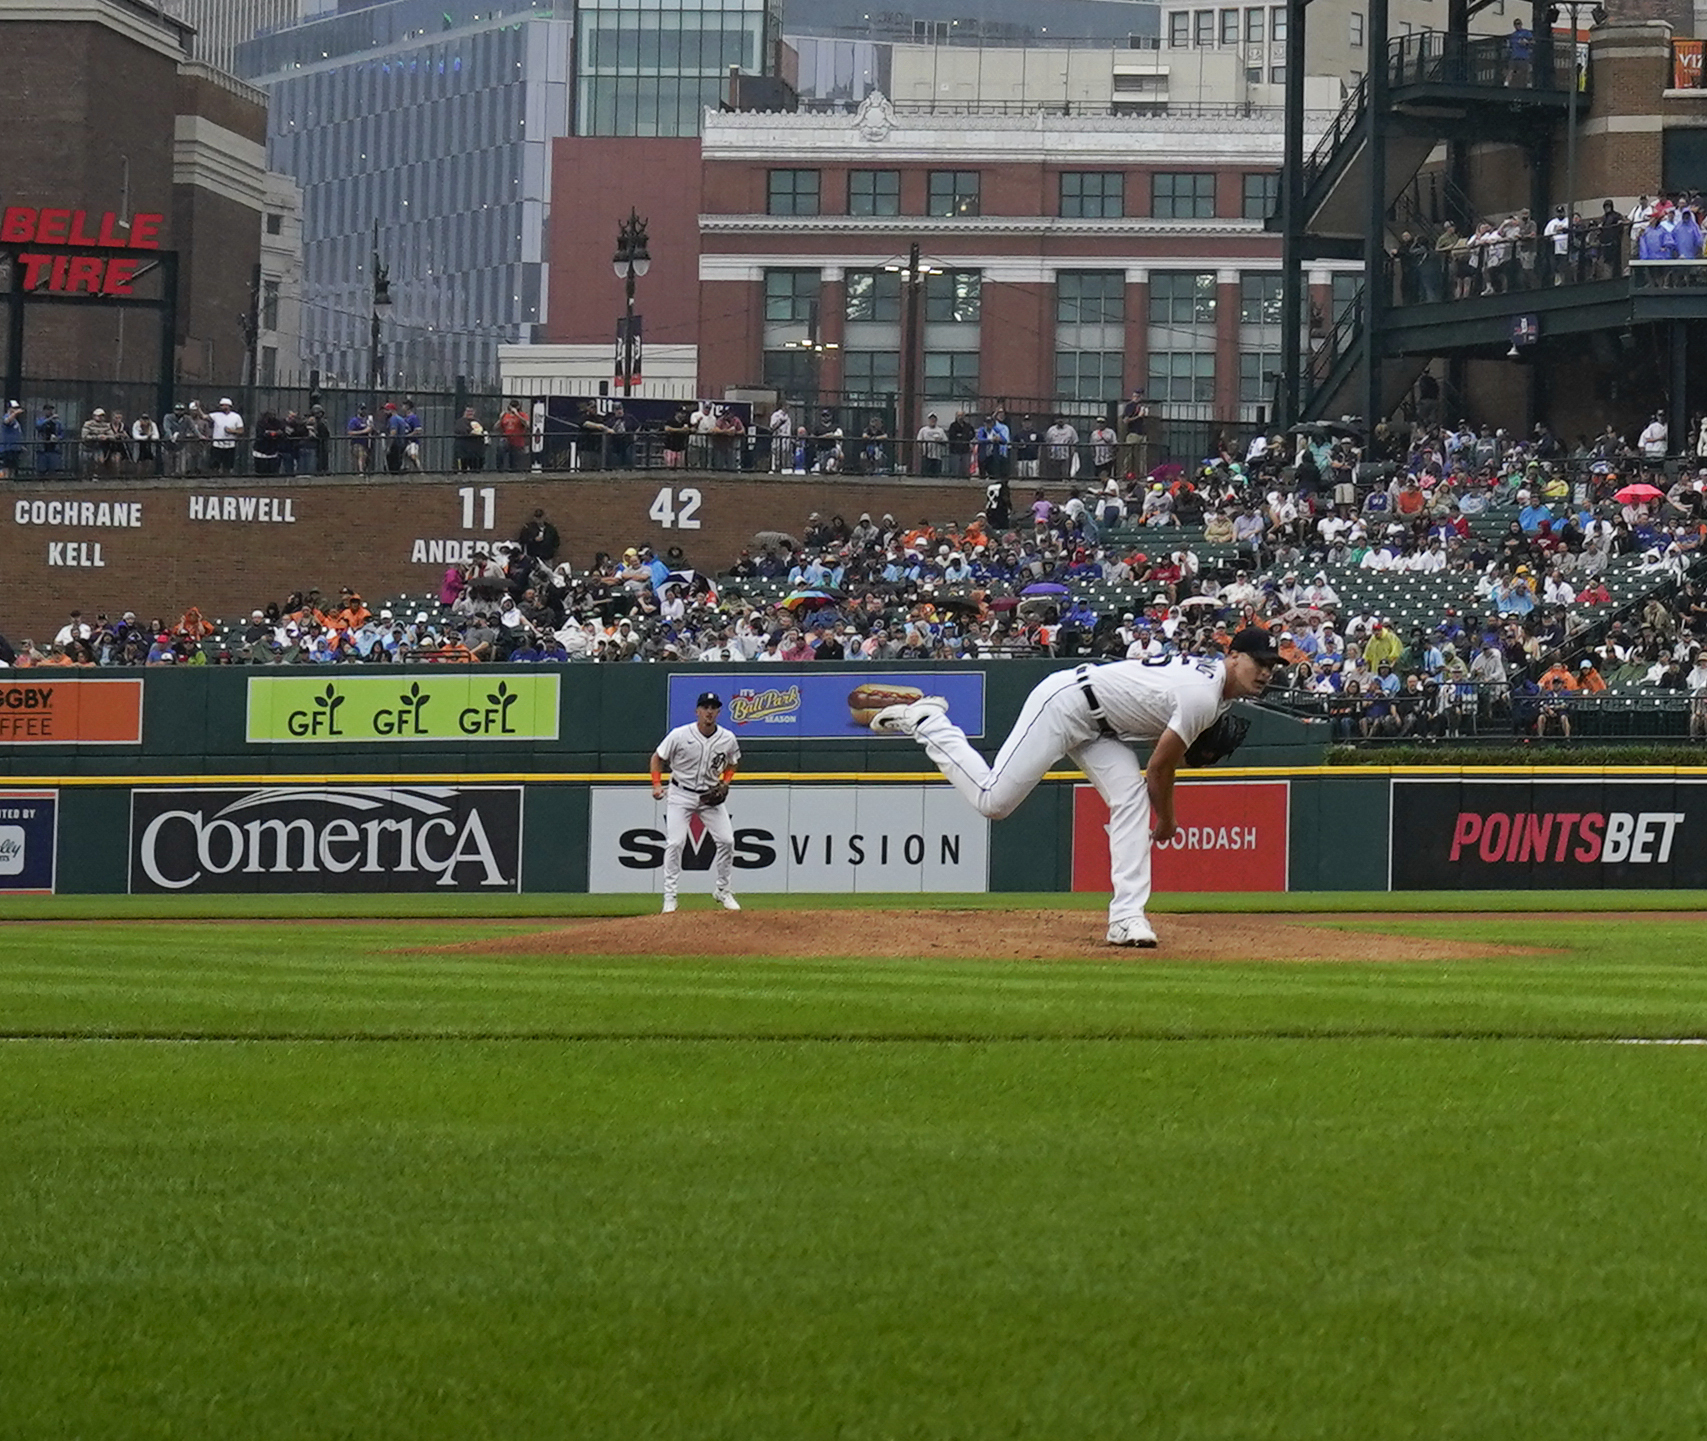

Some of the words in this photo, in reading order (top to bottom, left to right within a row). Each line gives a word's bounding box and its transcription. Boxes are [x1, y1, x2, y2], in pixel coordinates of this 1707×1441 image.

[0, 206, 164, 250] BELLE
[18, 252, 139, 295] TIRE
[14, 500, 142, 528] COCHRANE
[189, 495, 296, 523] HARWELL
[458, 486, 496, 530] 11
[649, 487, 703, 530] 42
[48, 541, 105, 567] KELL
[729, 697, 765, 724] Ball
[762, 684, 801, 713] Park
[740, 688, 755, 697] IT'S
[288, 698, 344, 736] GFL
[373, 697, 429, 735] GFL
[458, 696, 517, 734] GFL
[764, 715, 797, 724] SEASON
[22, 808, 36, 820] BY
[790, 833, 960, 866] VISION
[1449, 811, 1686, 864] POINTSBET
